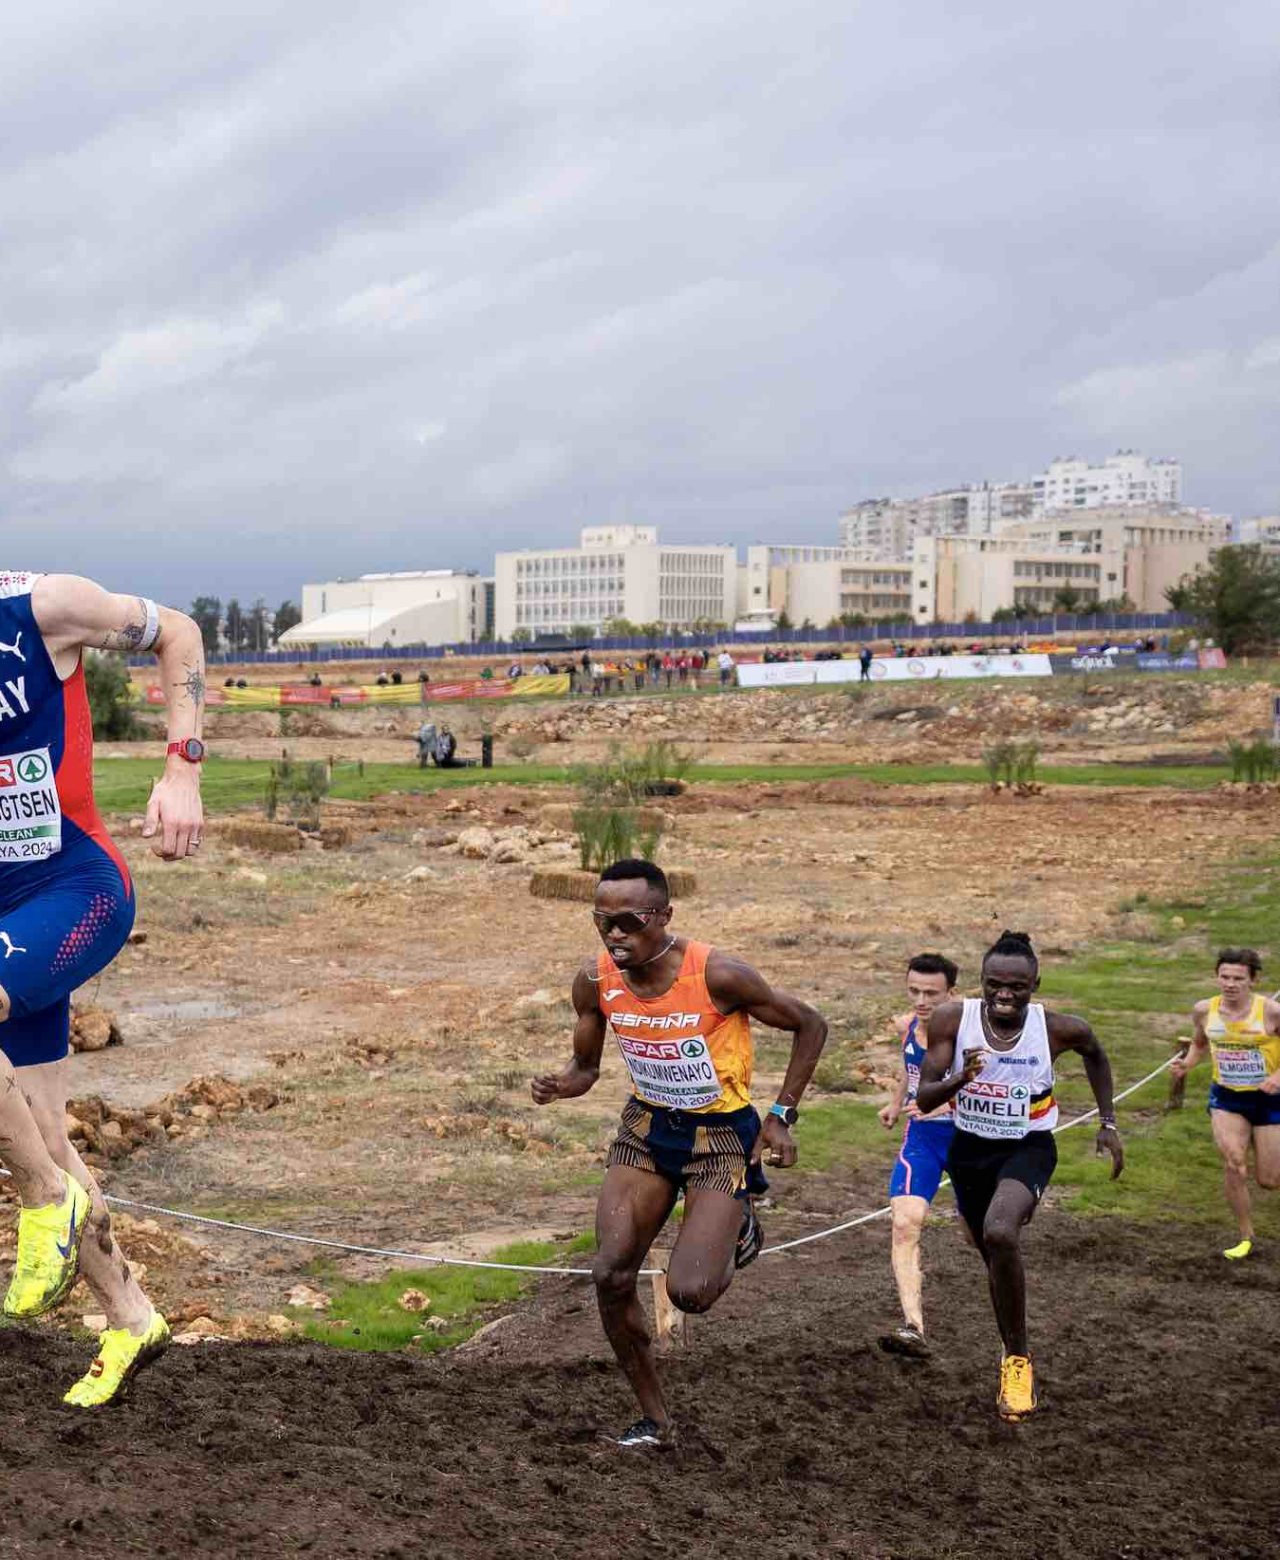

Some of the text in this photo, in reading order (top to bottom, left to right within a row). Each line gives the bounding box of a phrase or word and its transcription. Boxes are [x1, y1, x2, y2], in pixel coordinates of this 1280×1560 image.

[21, 842, 53, 856] 2024
[610, 1012, 701, 1029] ESPAÑA
[621, 1039, 679, 1059] SPAR
[998, 1056, 1027, 1065] Allianz
[966, 1082, 1008, 1097] PAR
[958, 1092, 1026, 1117] KIMELI
